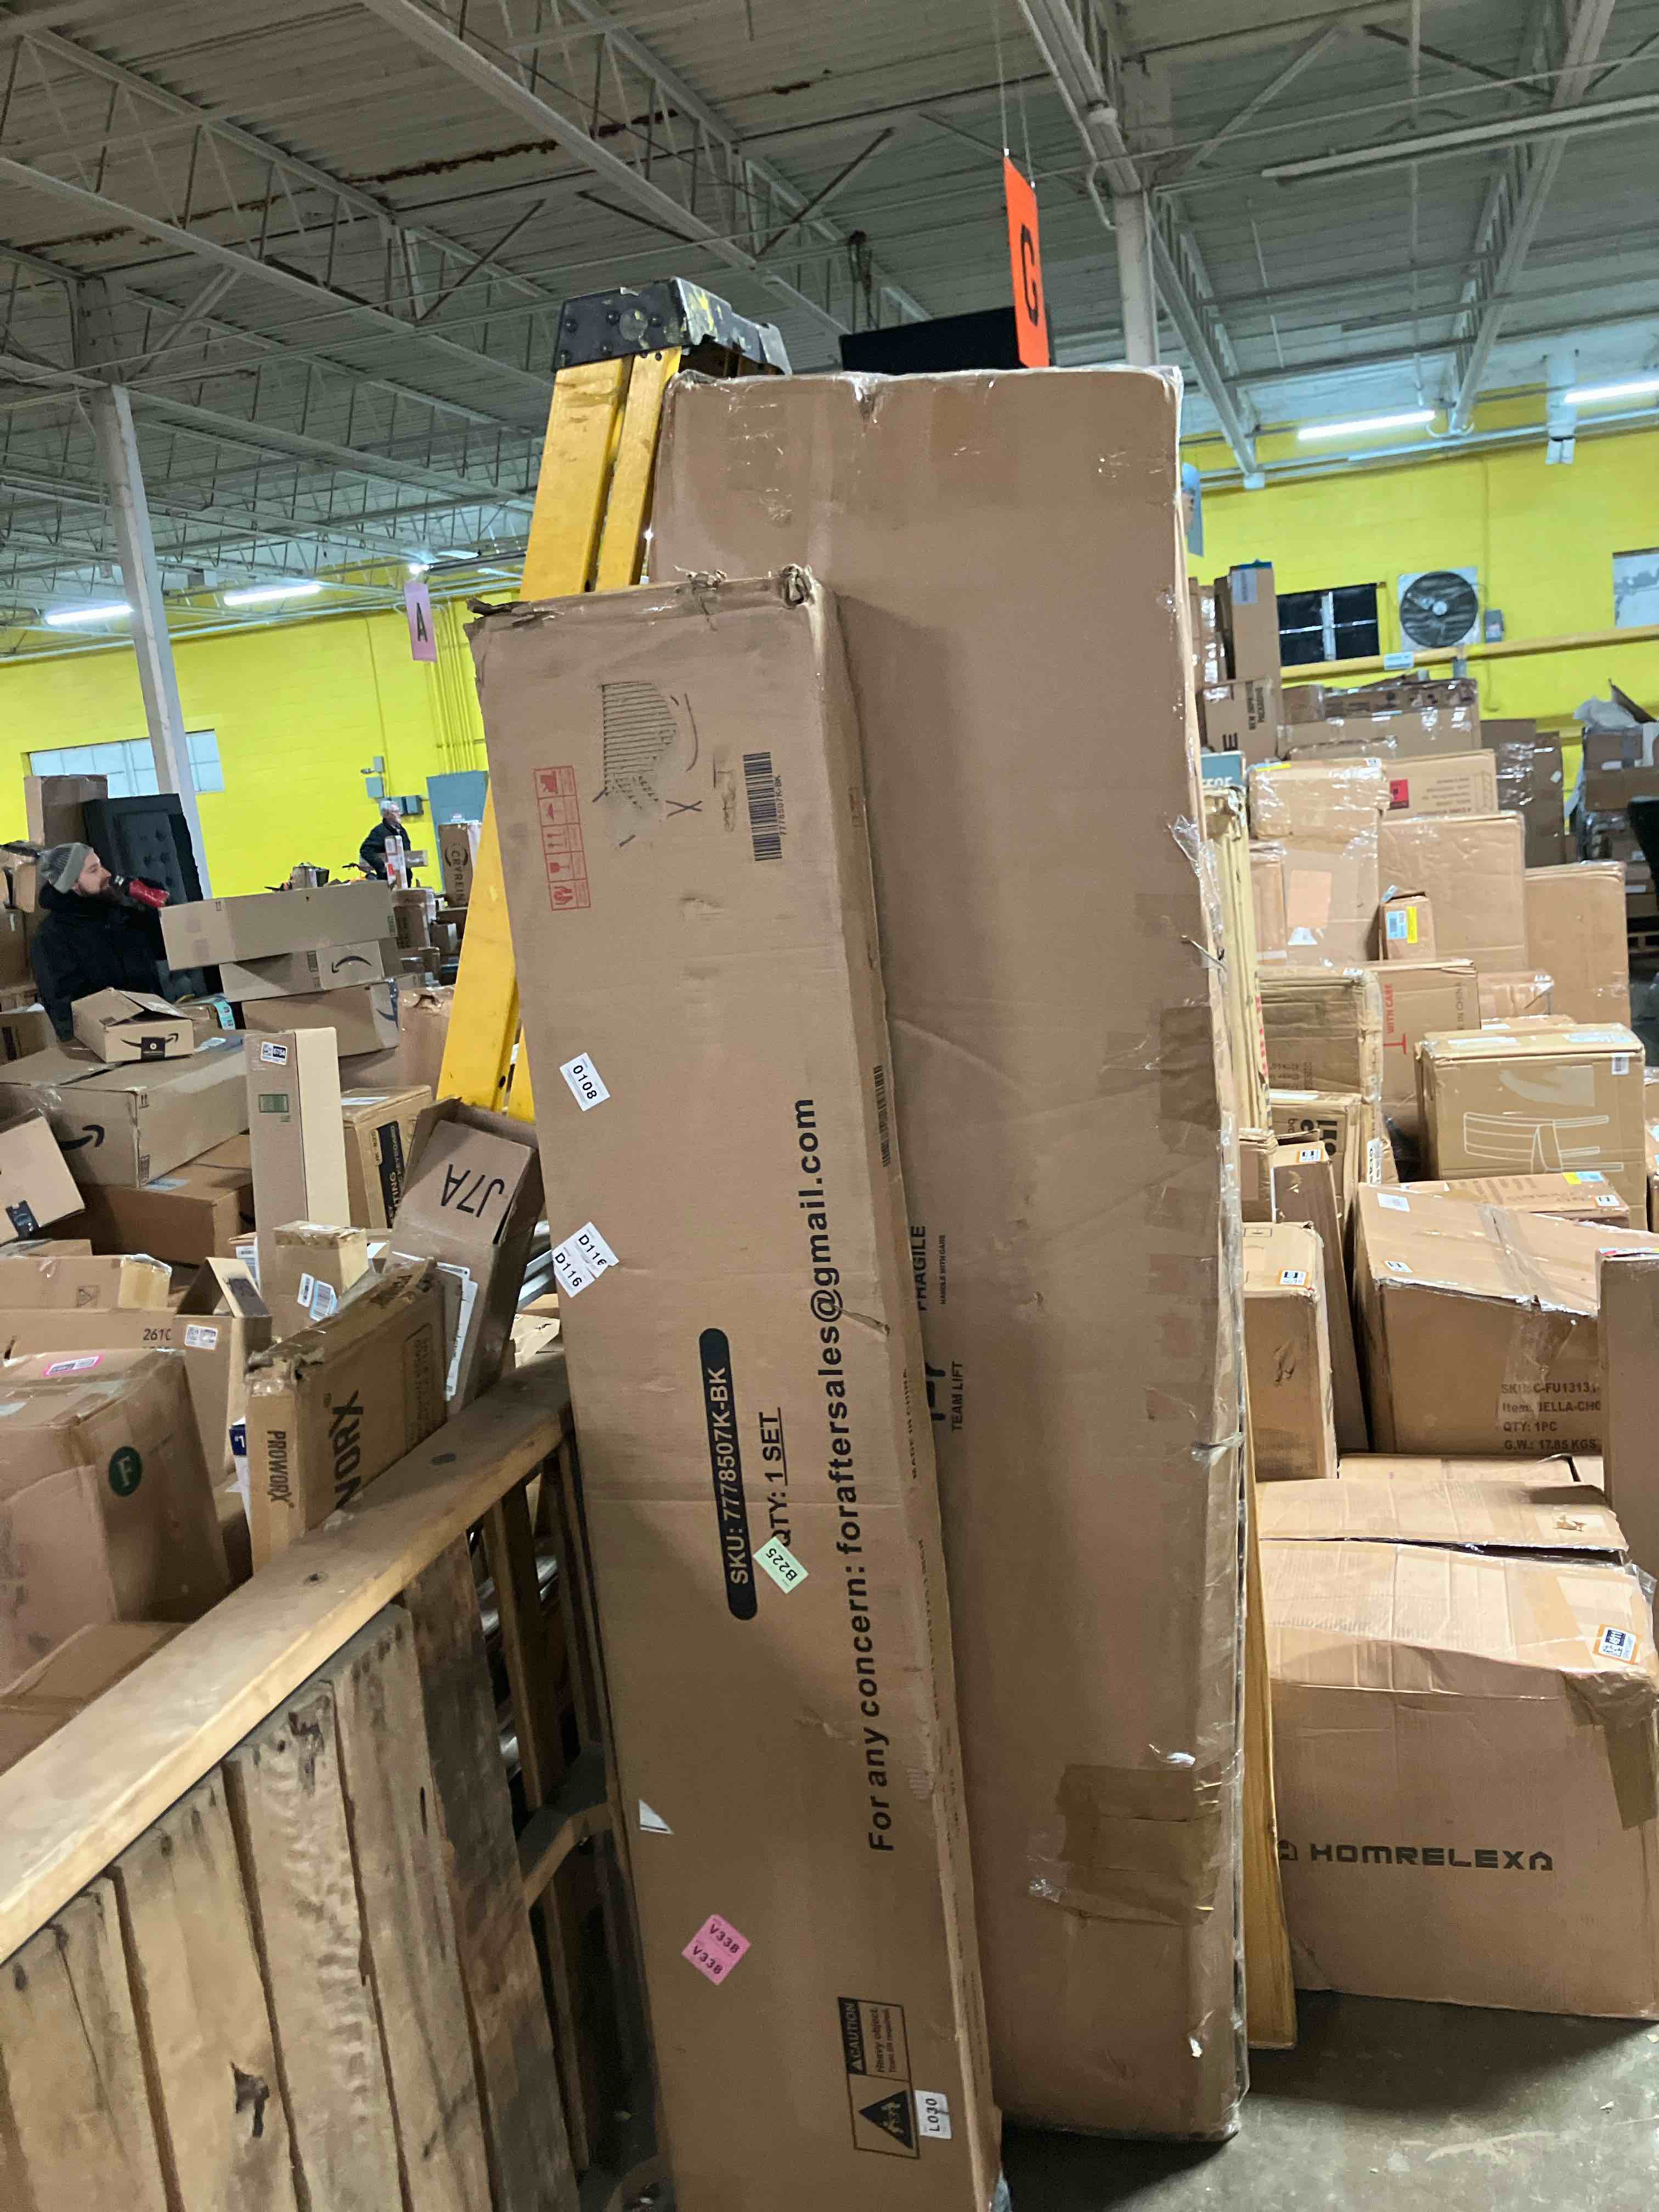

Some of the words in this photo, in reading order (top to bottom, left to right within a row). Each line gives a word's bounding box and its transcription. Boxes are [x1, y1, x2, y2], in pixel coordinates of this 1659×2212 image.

[1021, 224, 1039, 326] G
[416, 602, 428, 642] A
[441, 1164, 505, 1218] J7A
[555, 1251, 582, 1288] D116
[794, 1098, 862, 1555] foraftersales@gmail.com
[952, 1361, 964, 1390] LIFT
[758, 1412, 782, 1462] SET
[952, 1391, 964, 1432] TEAM
[1503, 1421, 1531, 1432] QTY:
[1536, 1421, 1558, 1432] 1PC
[266, 1430, 292, 1503] PROWORX
[708, 1366, 742, 1521] 7778507K-BK
[1571, 1438, 1598, 1450] KGS
[764, 1466, 785, 1482] 1
[768, 1491, 792, 1548] QTY:
[727, 1527, 749, 1585] SKU:
[765, 1547, 798, 1582] B225
[845, 1565, 881, 1718] concern:
[862, 1726, 890, 1787] any
[868, 1795, 894, 1852] For
[845, 2001, 863, 2059] CAUTION
[925, 2098, 941, 2132] L030
